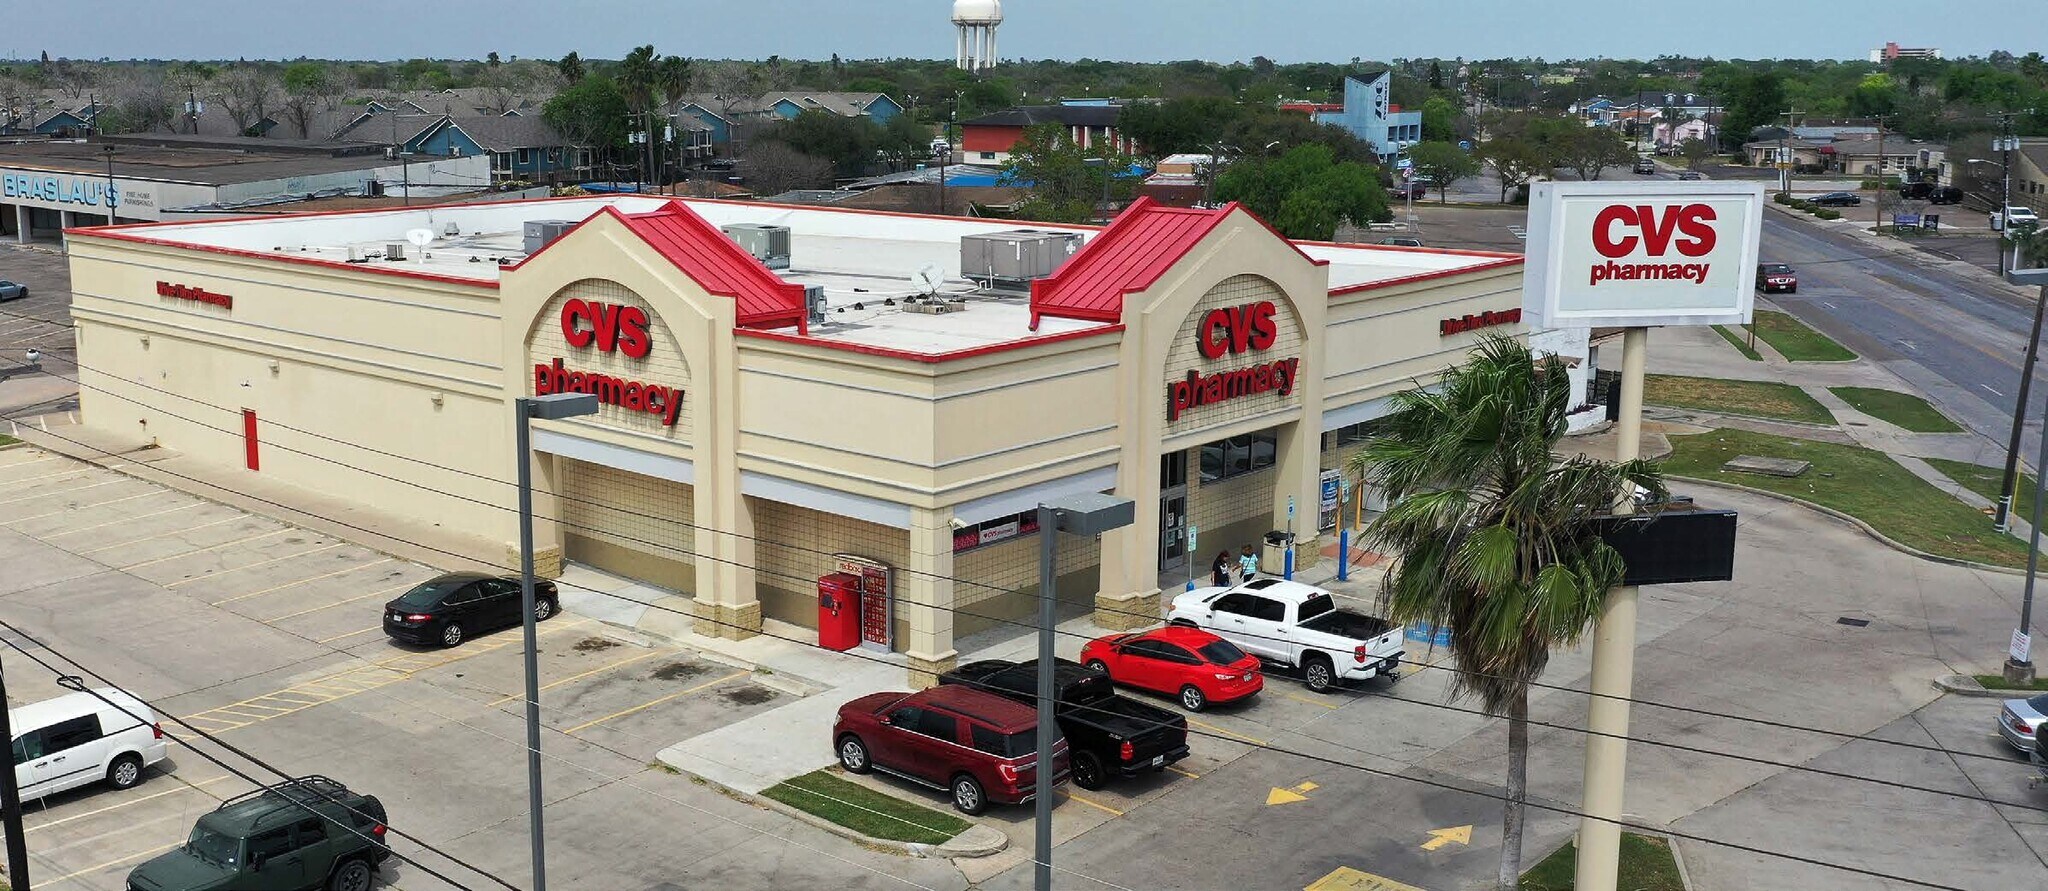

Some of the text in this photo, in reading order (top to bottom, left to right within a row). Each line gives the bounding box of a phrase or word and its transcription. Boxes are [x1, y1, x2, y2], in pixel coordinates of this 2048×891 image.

[3, 174, 119, 209] BRASLAU'S
[1592, 203, 1717, 258] CVS
[1590, 260, 1711, 286] pharmacy
[561, 298, 653, 359] CVS
[1195, 301, 1277, 359] CVS
[535, 357, 685, 426] pharmacy
[1167, 357, 1299, 422] pharmacy
